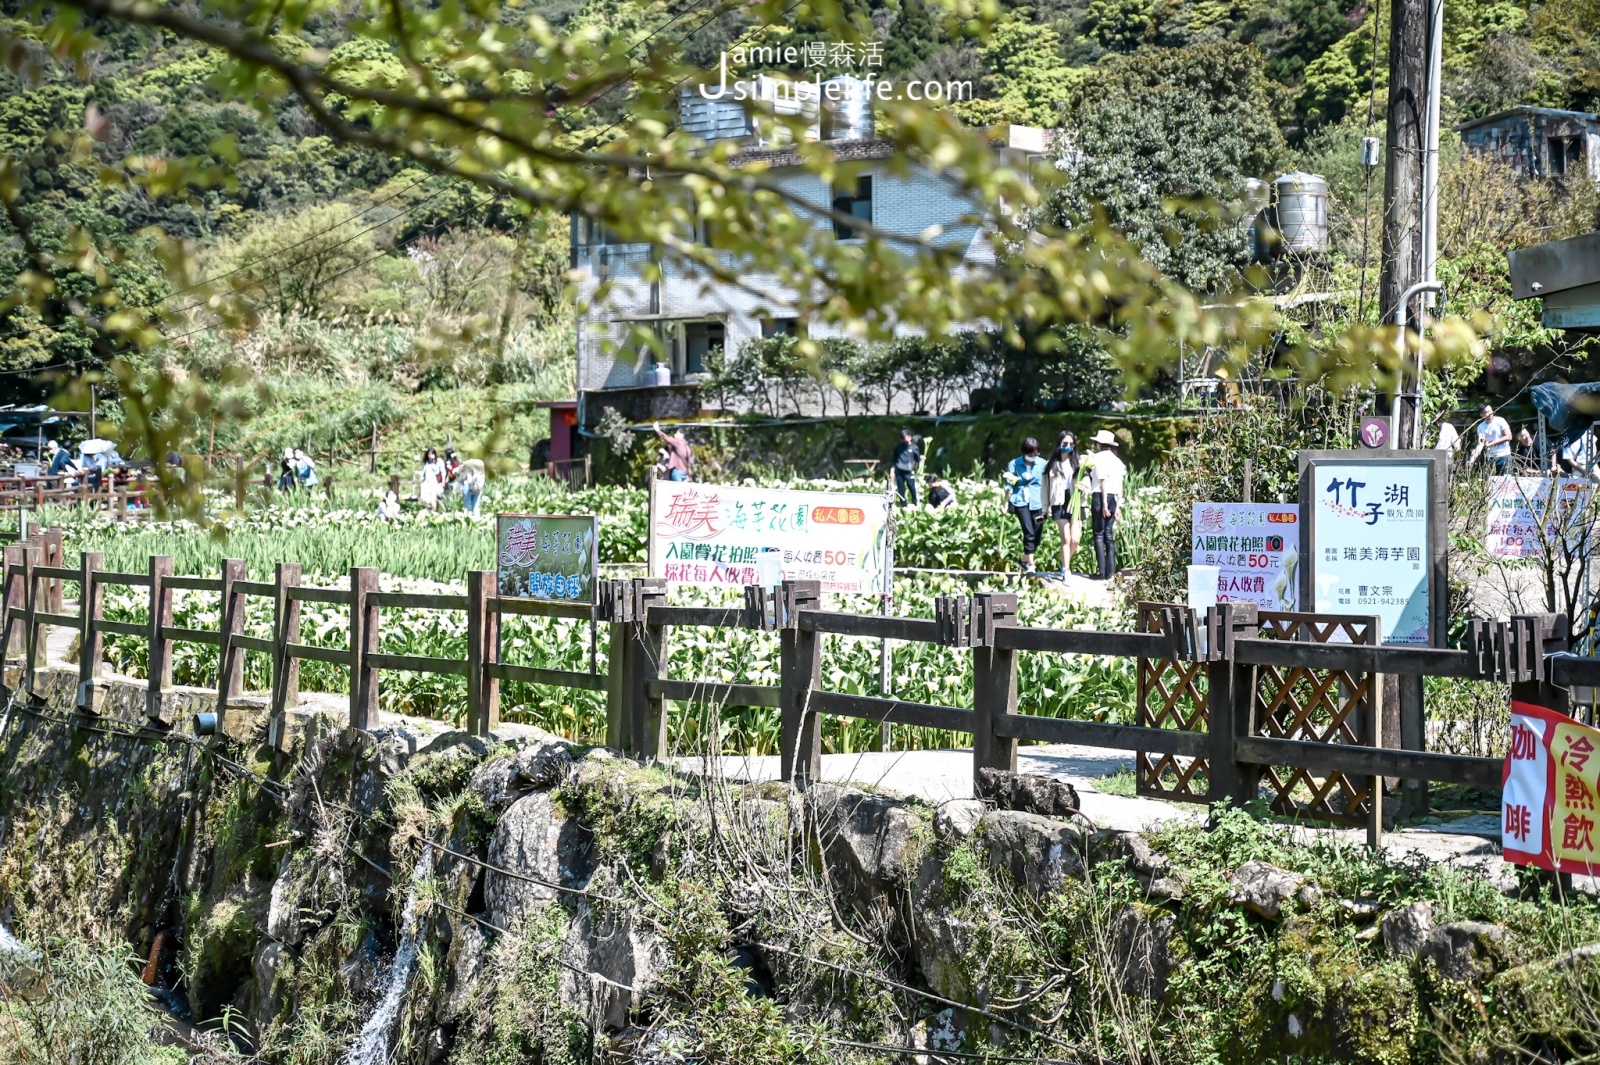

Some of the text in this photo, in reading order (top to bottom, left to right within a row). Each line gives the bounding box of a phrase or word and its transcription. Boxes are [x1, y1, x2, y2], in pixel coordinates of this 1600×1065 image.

[1343, 547, 1420, 561] 瑞美海芋園
[1561, 735, 1595, 852] 冷熱飲
